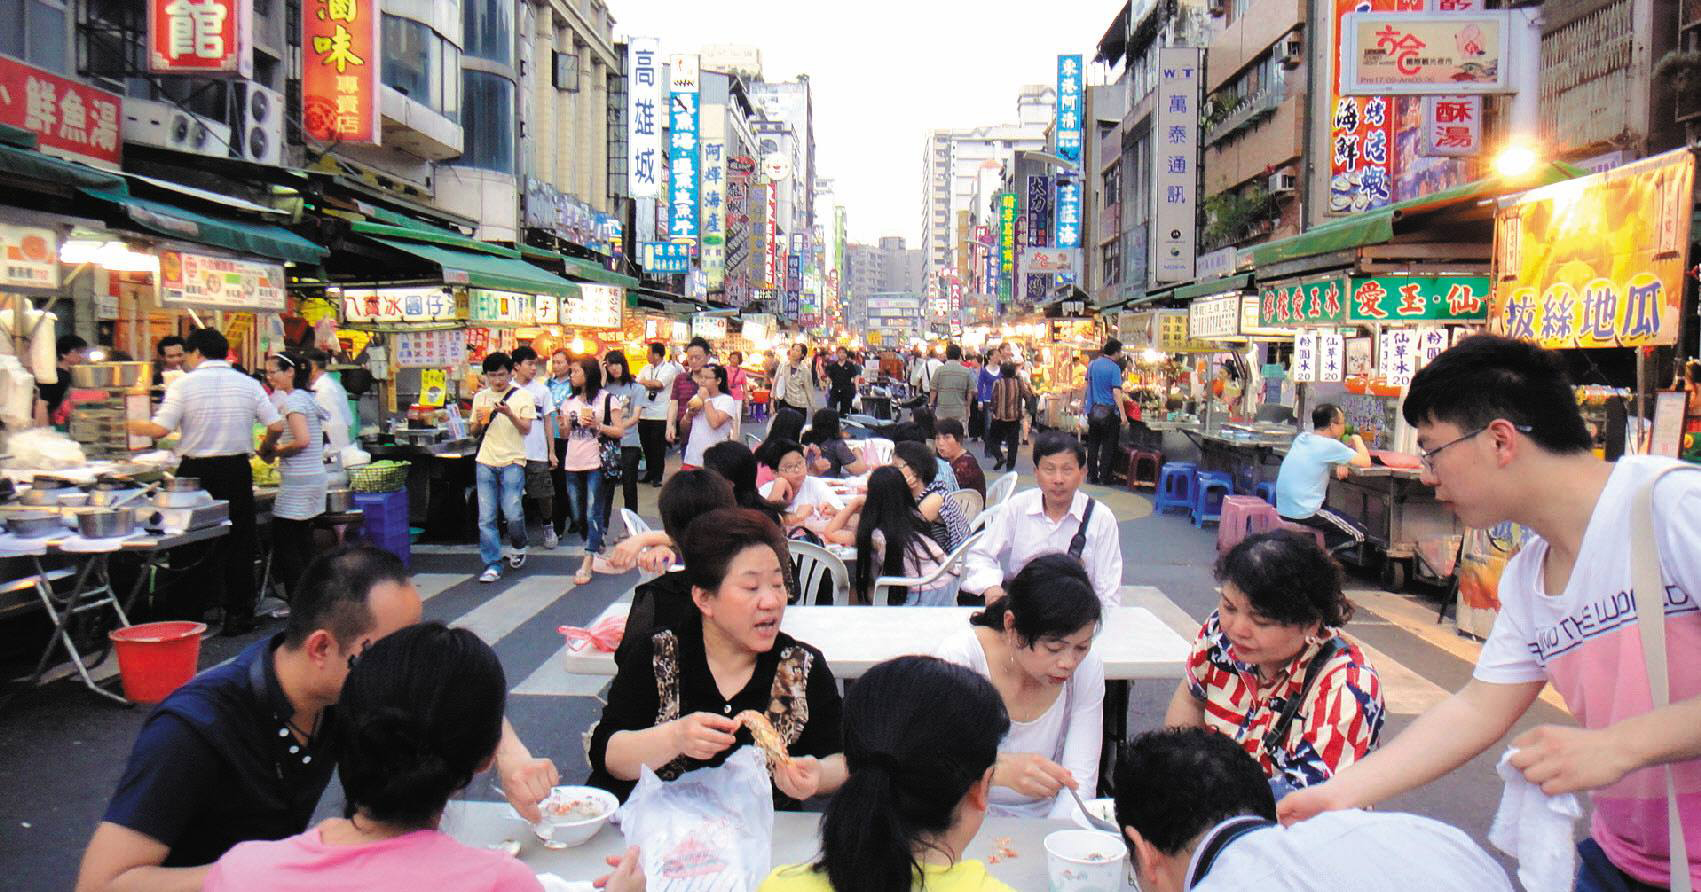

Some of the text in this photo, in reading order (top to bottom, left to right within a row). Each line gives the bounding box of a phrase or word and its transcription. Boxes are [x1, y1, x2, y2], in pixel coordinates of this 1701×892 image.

[164, 1, 228, 60] 館
[0, 76, 118, 152] 鮮魚湯
[335, 75, 359, 134] 專賣店
[635, 49, 655, 184] 高雄城
[1437, 102, 1473, 148] 酥湯
[1167, 95, 1187, 204] 萬泰通訊
[1334, 101, 1358, 171] 海鮮
[1263, 281, 1342, 323] 檸檬愛玉冰
[1505, 282, 1662, 339] 拔絲地瓜
[1298, 373, 1311, 381] 20
[1325, 337, 1339, 372] 仙草冰
[1325, 373, 1339, 381] 20
[1393, 333, 1410, 374] 仙草冰
[1393, 376, 1410, 385] 20
